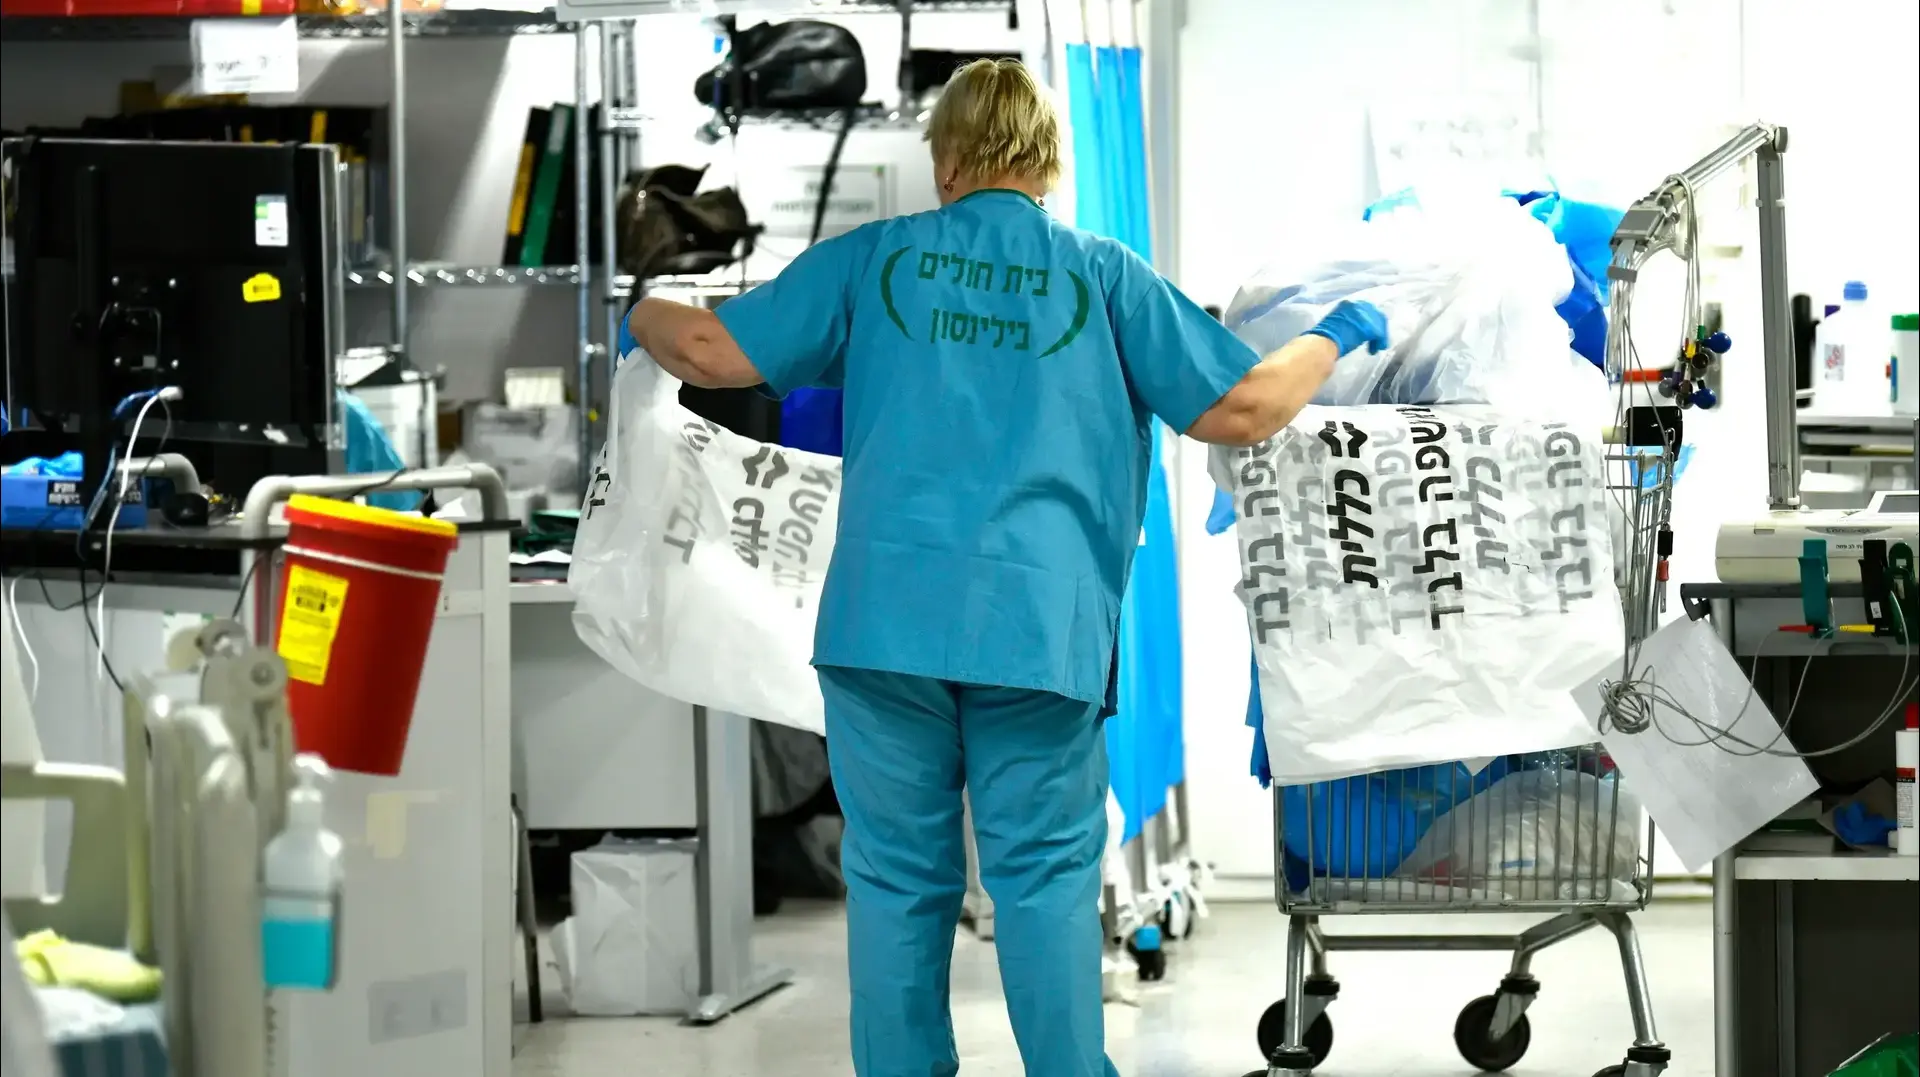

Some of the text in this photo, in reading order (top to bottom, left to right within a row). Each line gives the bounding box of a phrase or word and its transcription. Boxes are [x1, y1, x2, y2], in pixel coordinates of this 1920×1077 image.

[918, 251, 1049, 297] בית חולים
[930, 307, 1030, 351] בילינסון
[1326, 469, 1379, 589] כללית
[1459, 456, 1511, 575] כללית
[1541, 504, 1593, 614] בלבד
[1243, 532, 1290, 644] בלבד
[1412, 518, 1465, 631] בלבד
